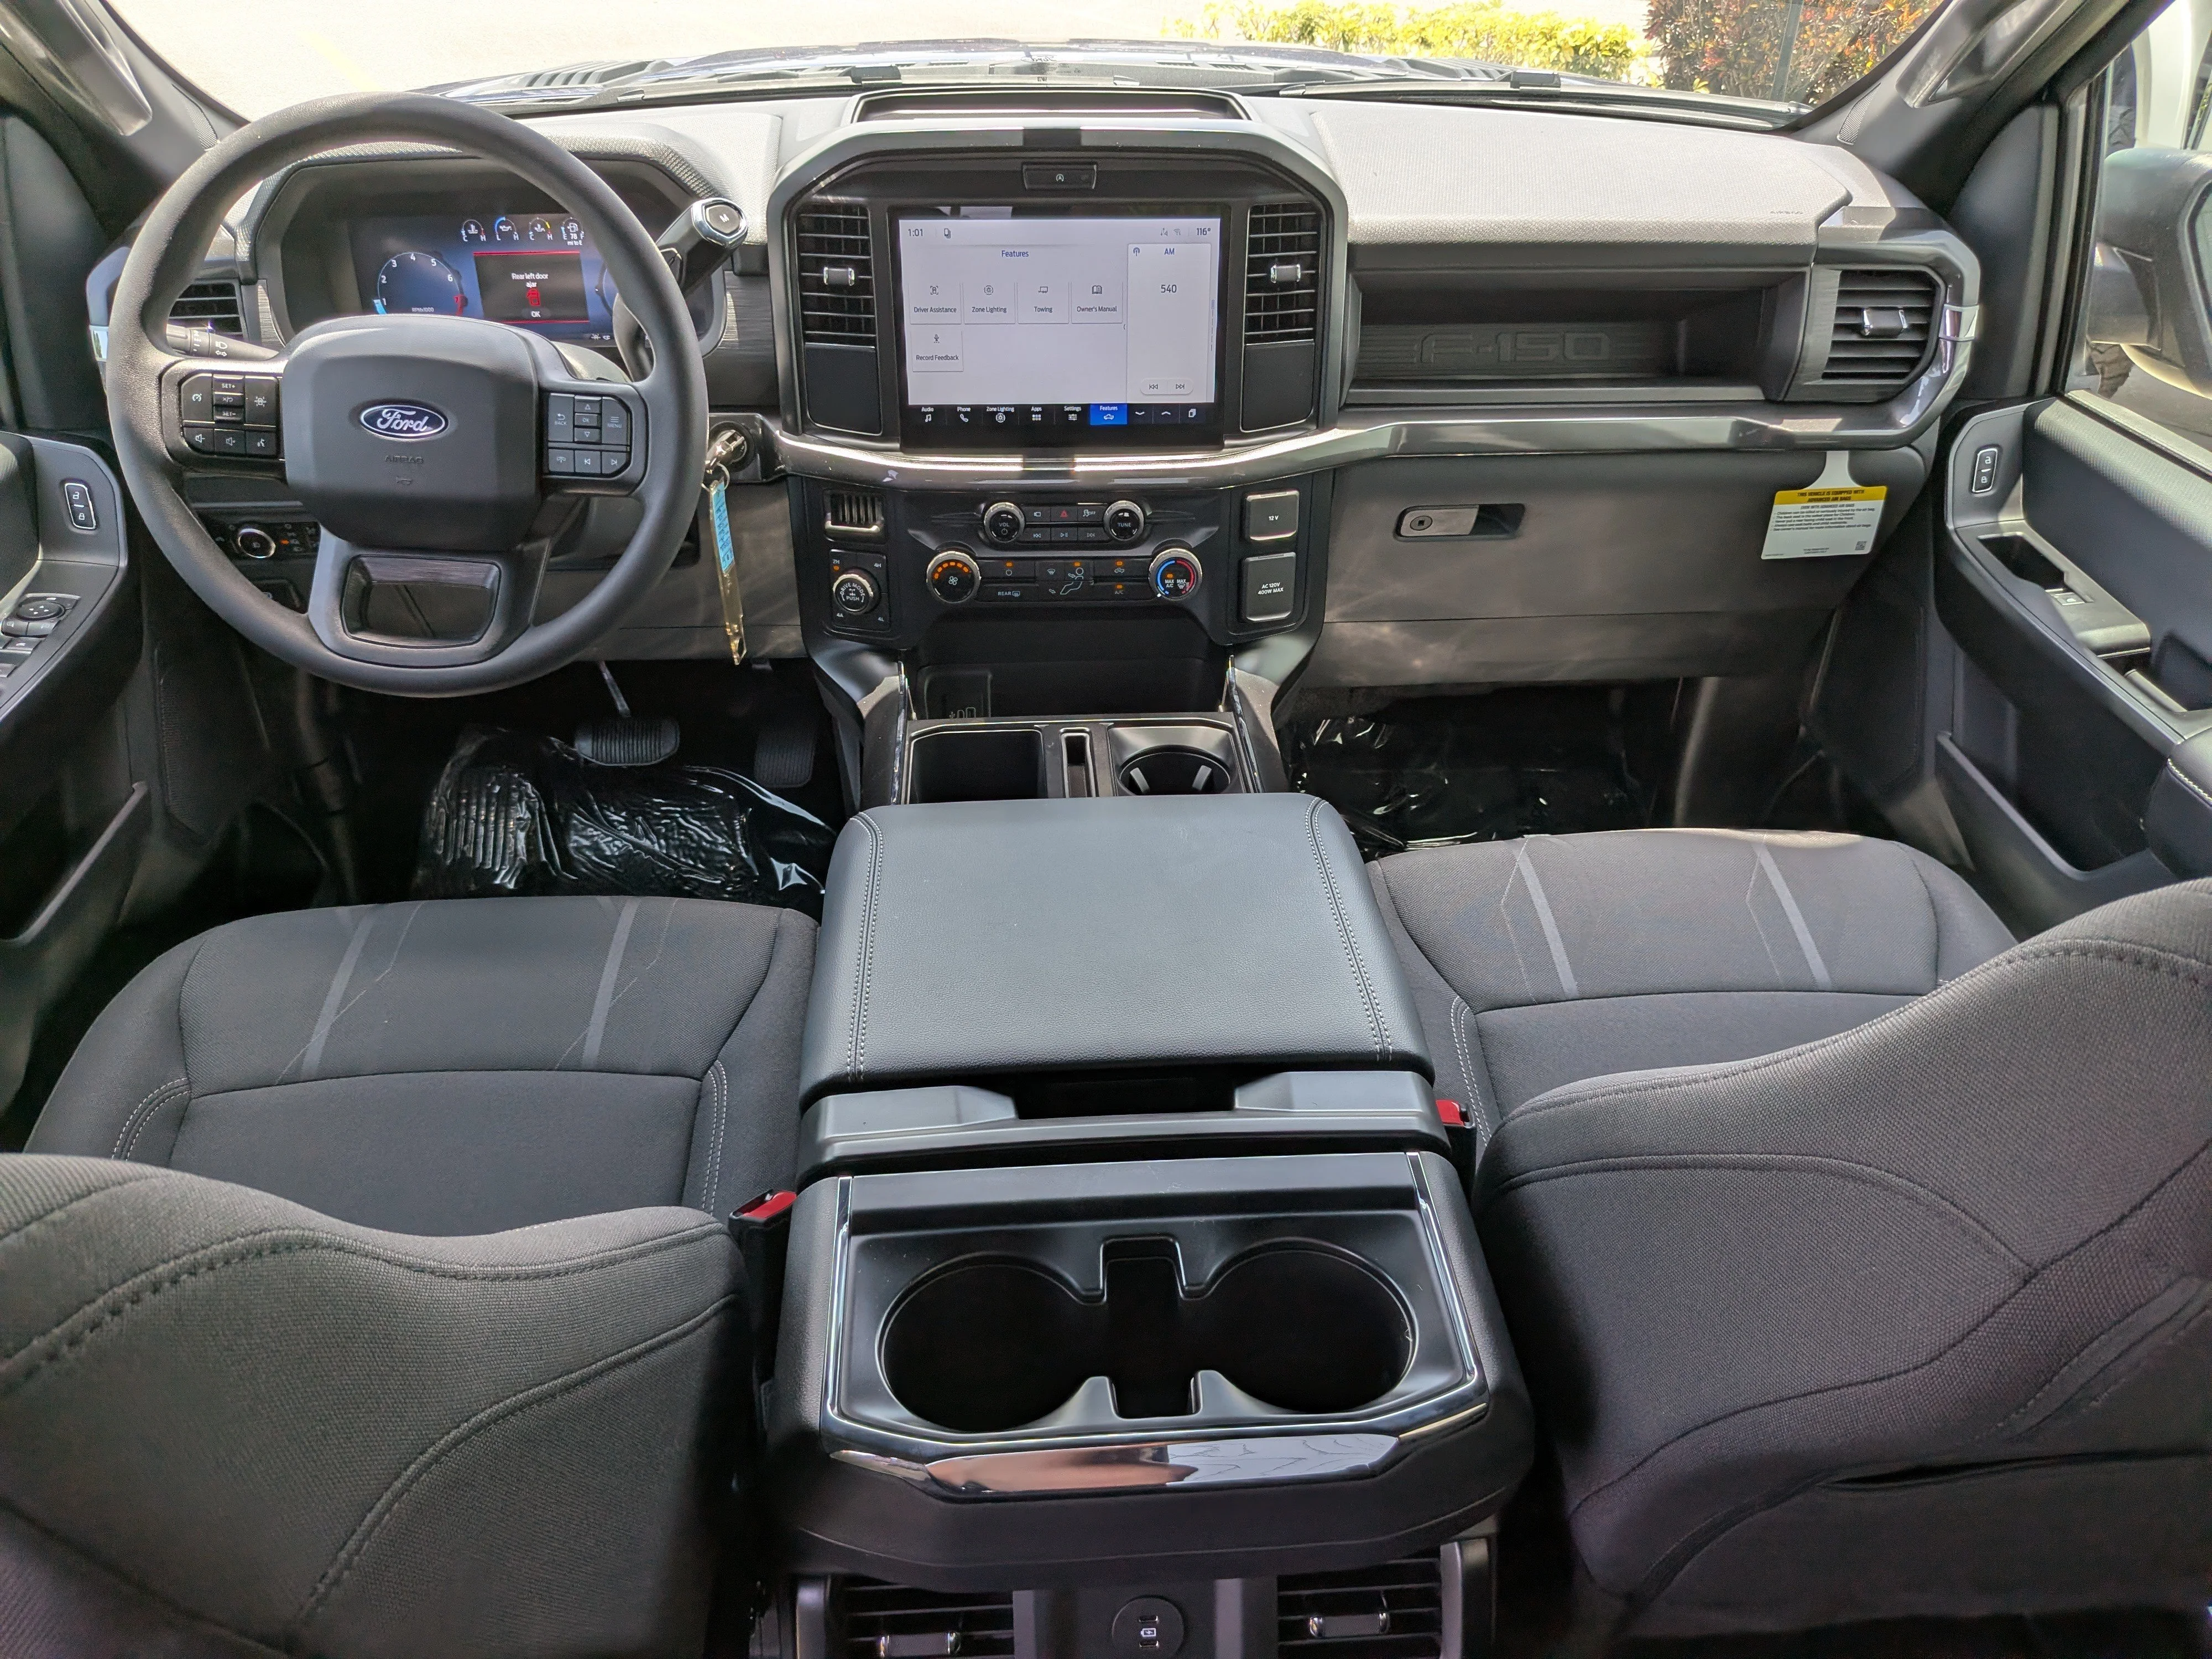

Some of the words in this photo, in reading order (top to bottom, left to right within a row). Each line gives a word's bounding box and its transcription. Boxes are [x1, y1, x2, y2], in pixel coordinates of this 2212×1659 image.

[719, 213, 729, 223] M
[908, 228, 924, 237] 1:01
[392, 259, 397, 268] 3
[431, 258, 437, 267] 5
[381, 275, 387, 284] 2
[1161, 284, 1177, 293] 540
[1419, 331, 1611, 363] F-150
[377, 409, 429, 431] Ford
[839, 582, 852, 595] DRIVE
[852, 582, 865, 597] MODE
